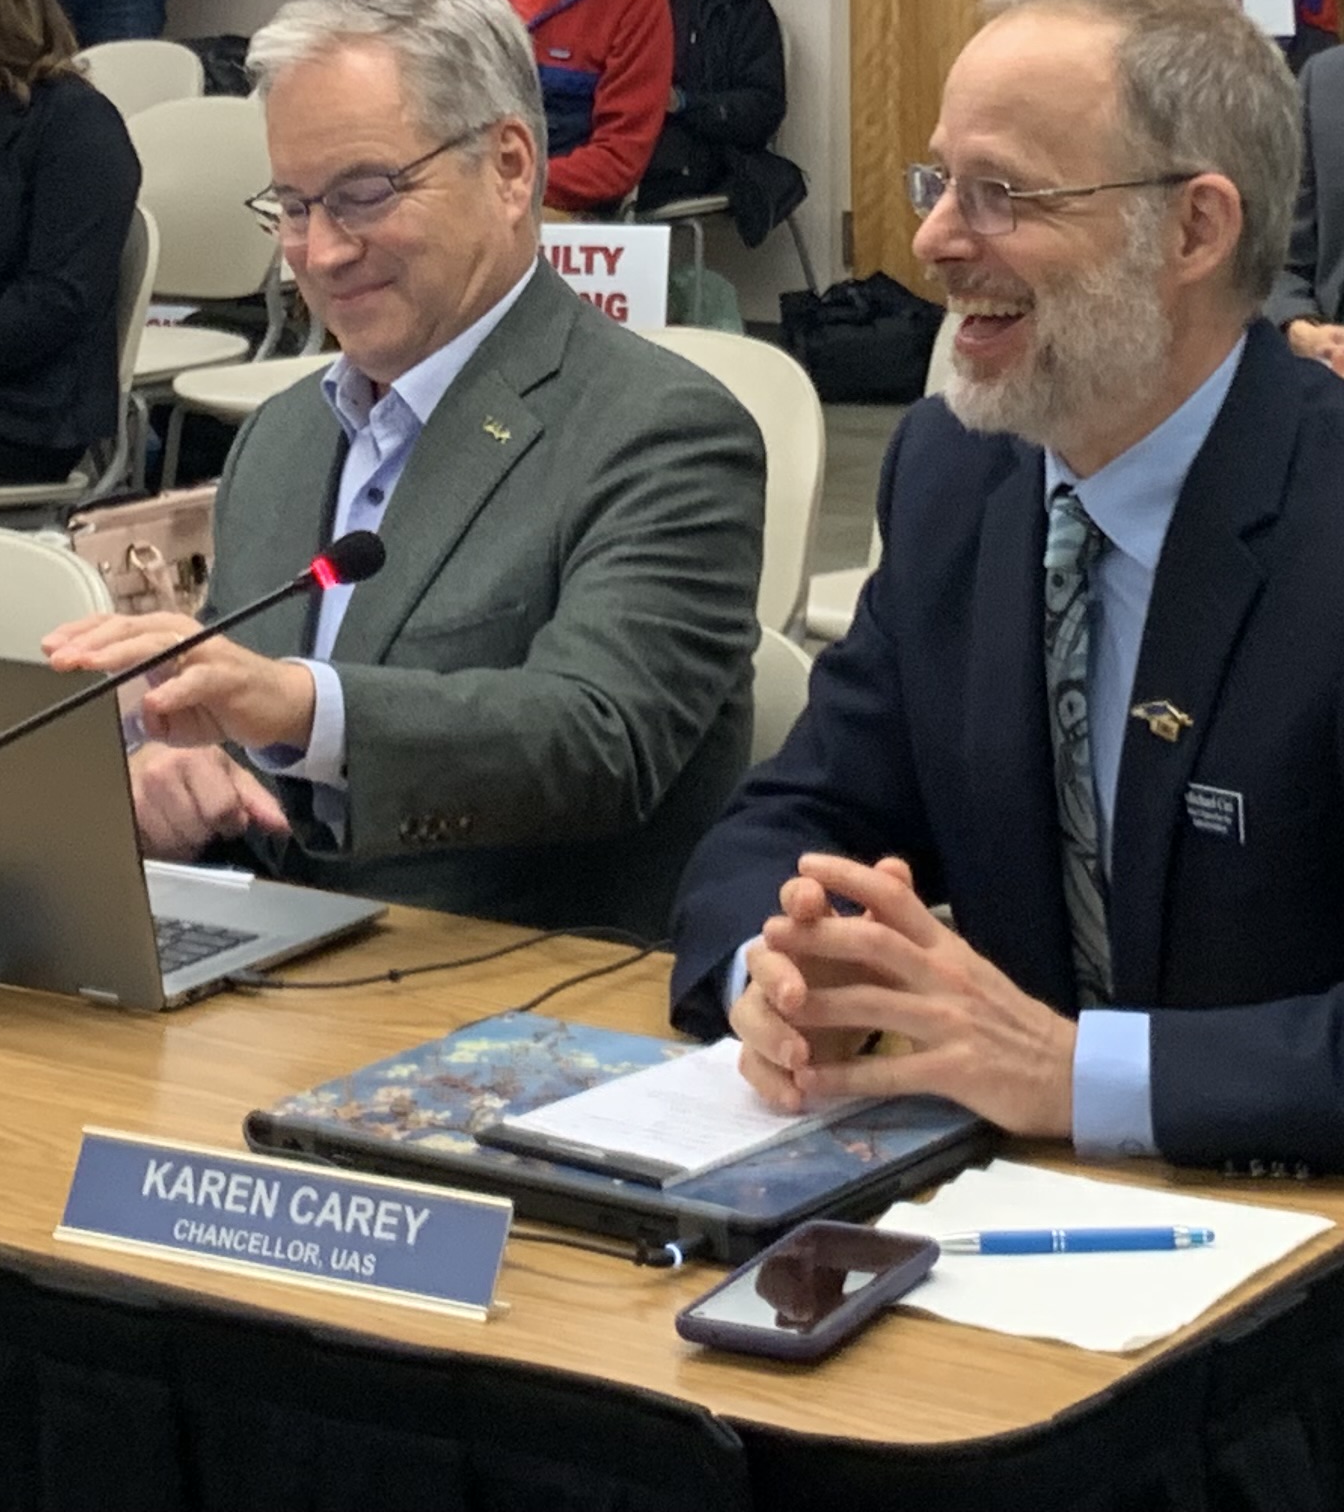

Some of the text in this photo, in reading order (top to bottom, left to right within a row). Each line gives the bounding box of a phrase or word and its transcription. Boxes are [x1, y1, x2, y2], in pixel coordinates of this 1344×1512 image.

[141, 1159, 431, 1247] KAREN CAREY
[173, 1218, 377, 1276] CHANCELLOR, UAS
